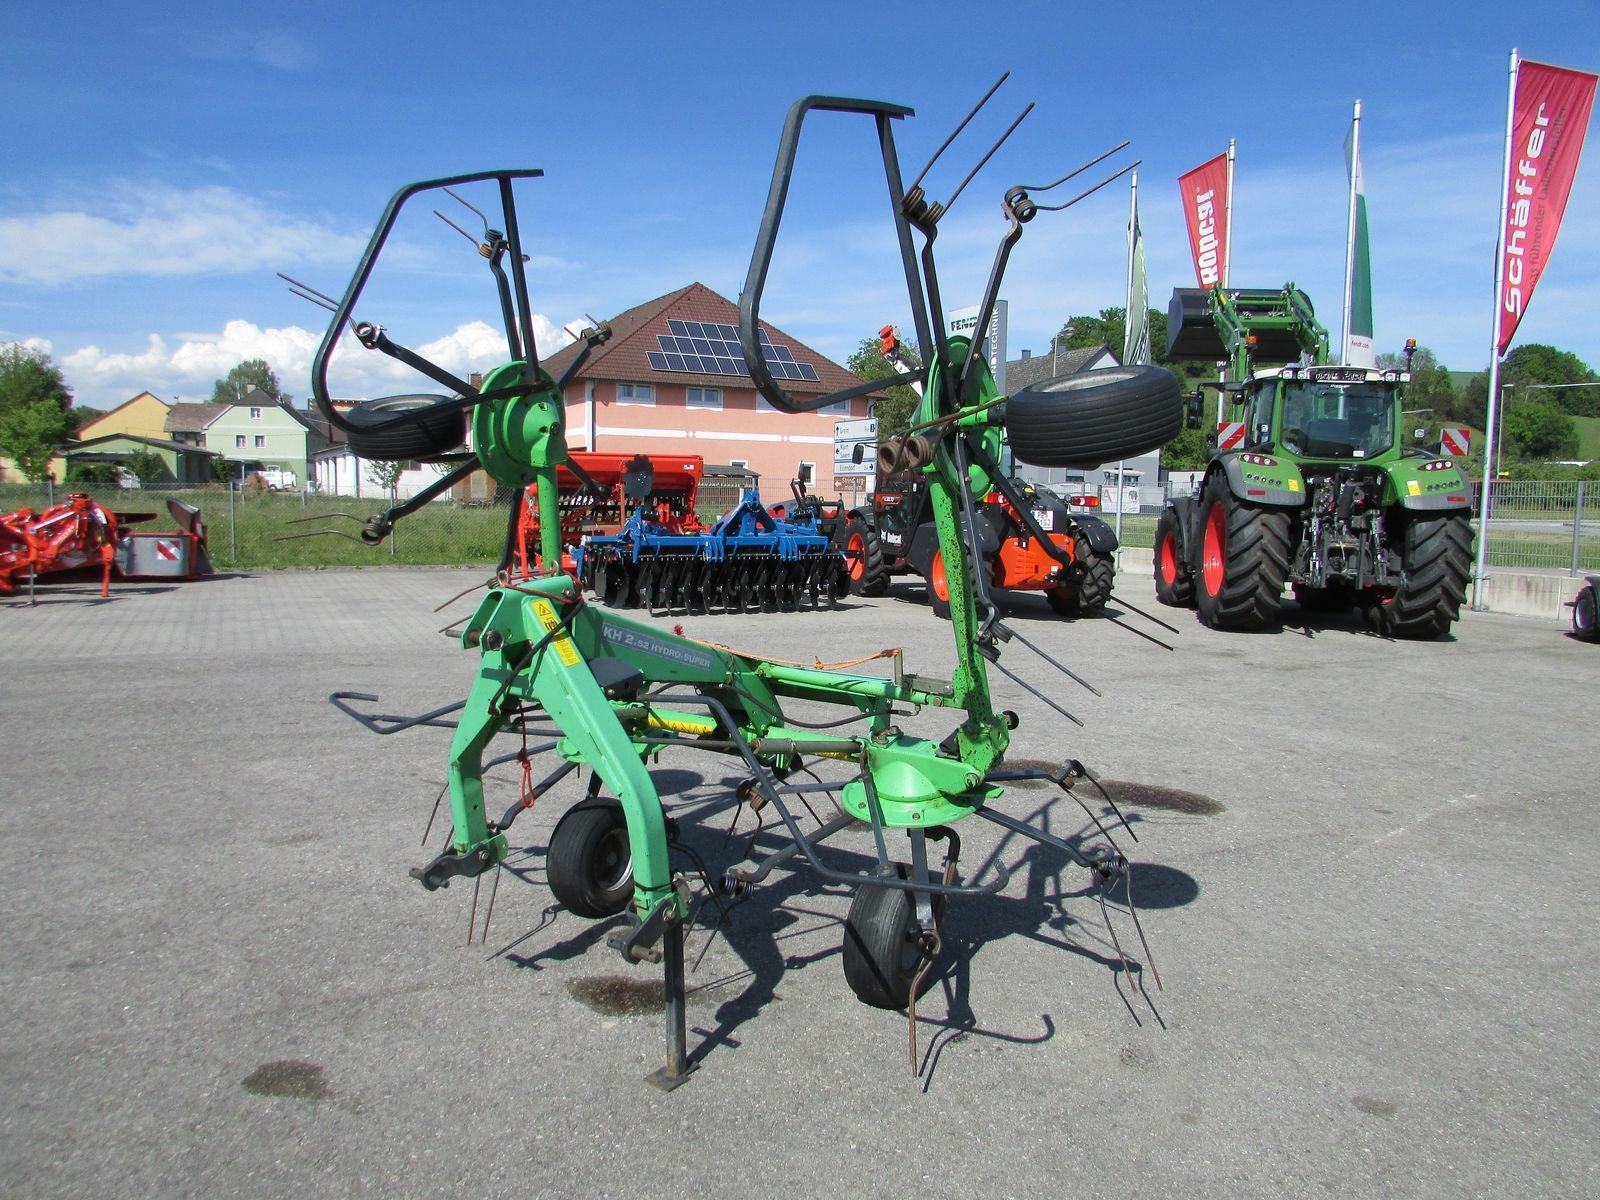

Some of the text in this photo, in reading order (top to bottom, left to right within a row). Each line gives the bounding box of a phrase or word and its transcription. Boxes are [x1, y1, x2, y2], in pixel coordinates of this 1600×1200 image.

[1505, 102, 1549, 321] Schäffer
[1529, 204, 1544, 264] führender
[603, 626, 711, 668] KH 2.52 HYDRO-SUPER
